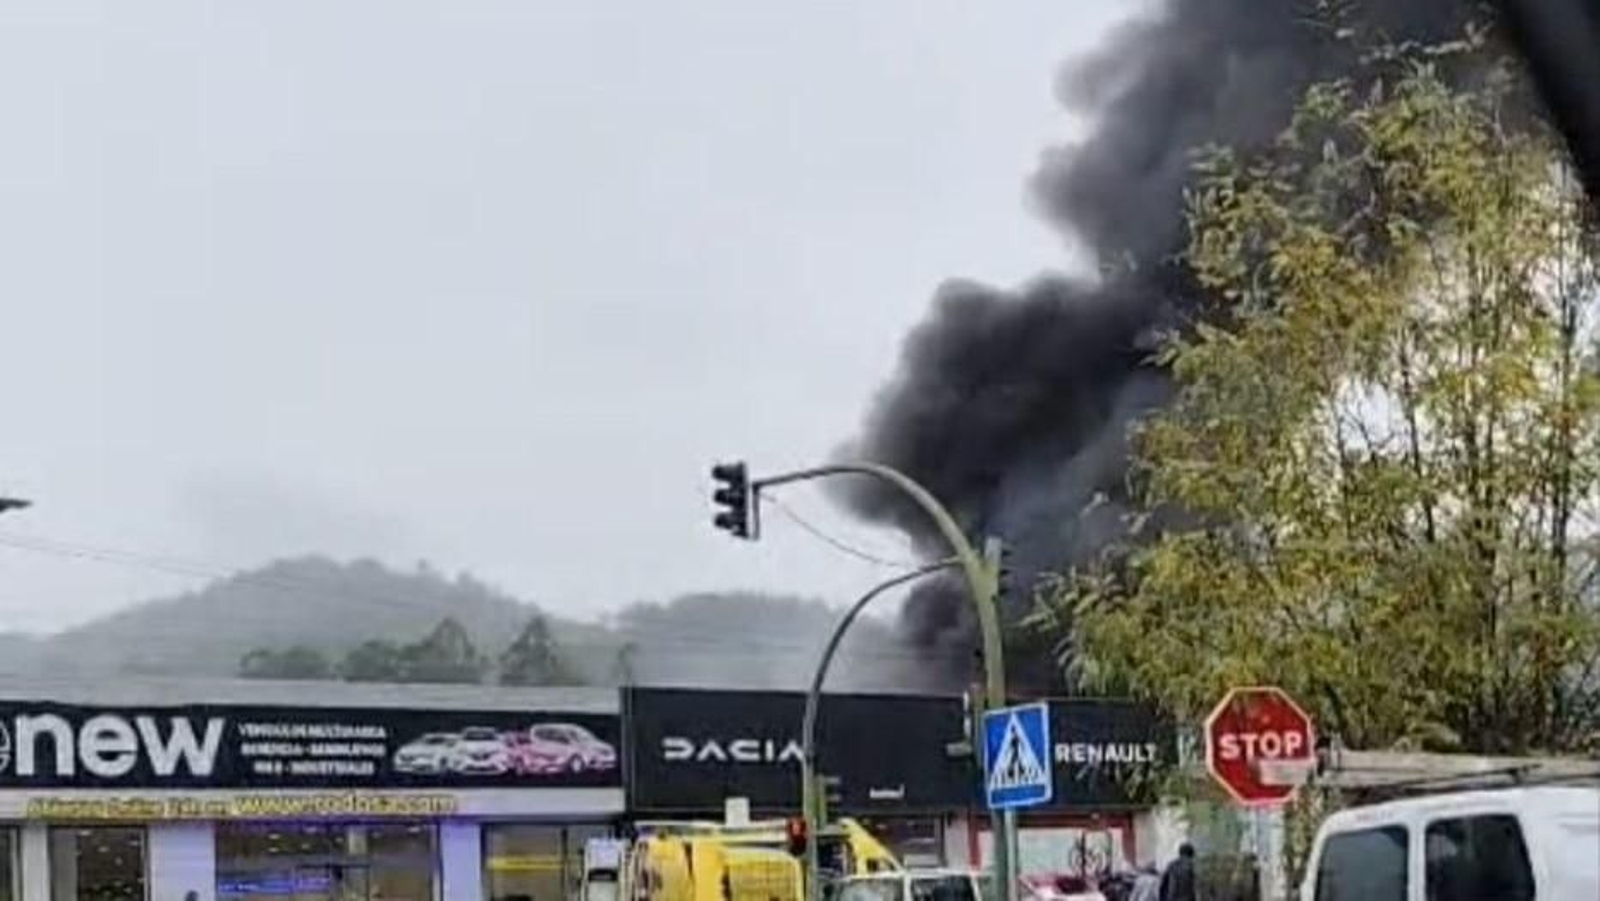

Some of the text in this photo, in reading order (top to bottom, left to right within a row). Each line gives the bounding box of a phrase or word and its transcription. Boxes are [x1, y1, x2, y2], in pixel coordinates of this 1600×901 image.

[663, 737, 804, 762] DACIA
[1055, 742, 1156, 764] RENAULT
[1219, 731, 1302, 760] STOP
